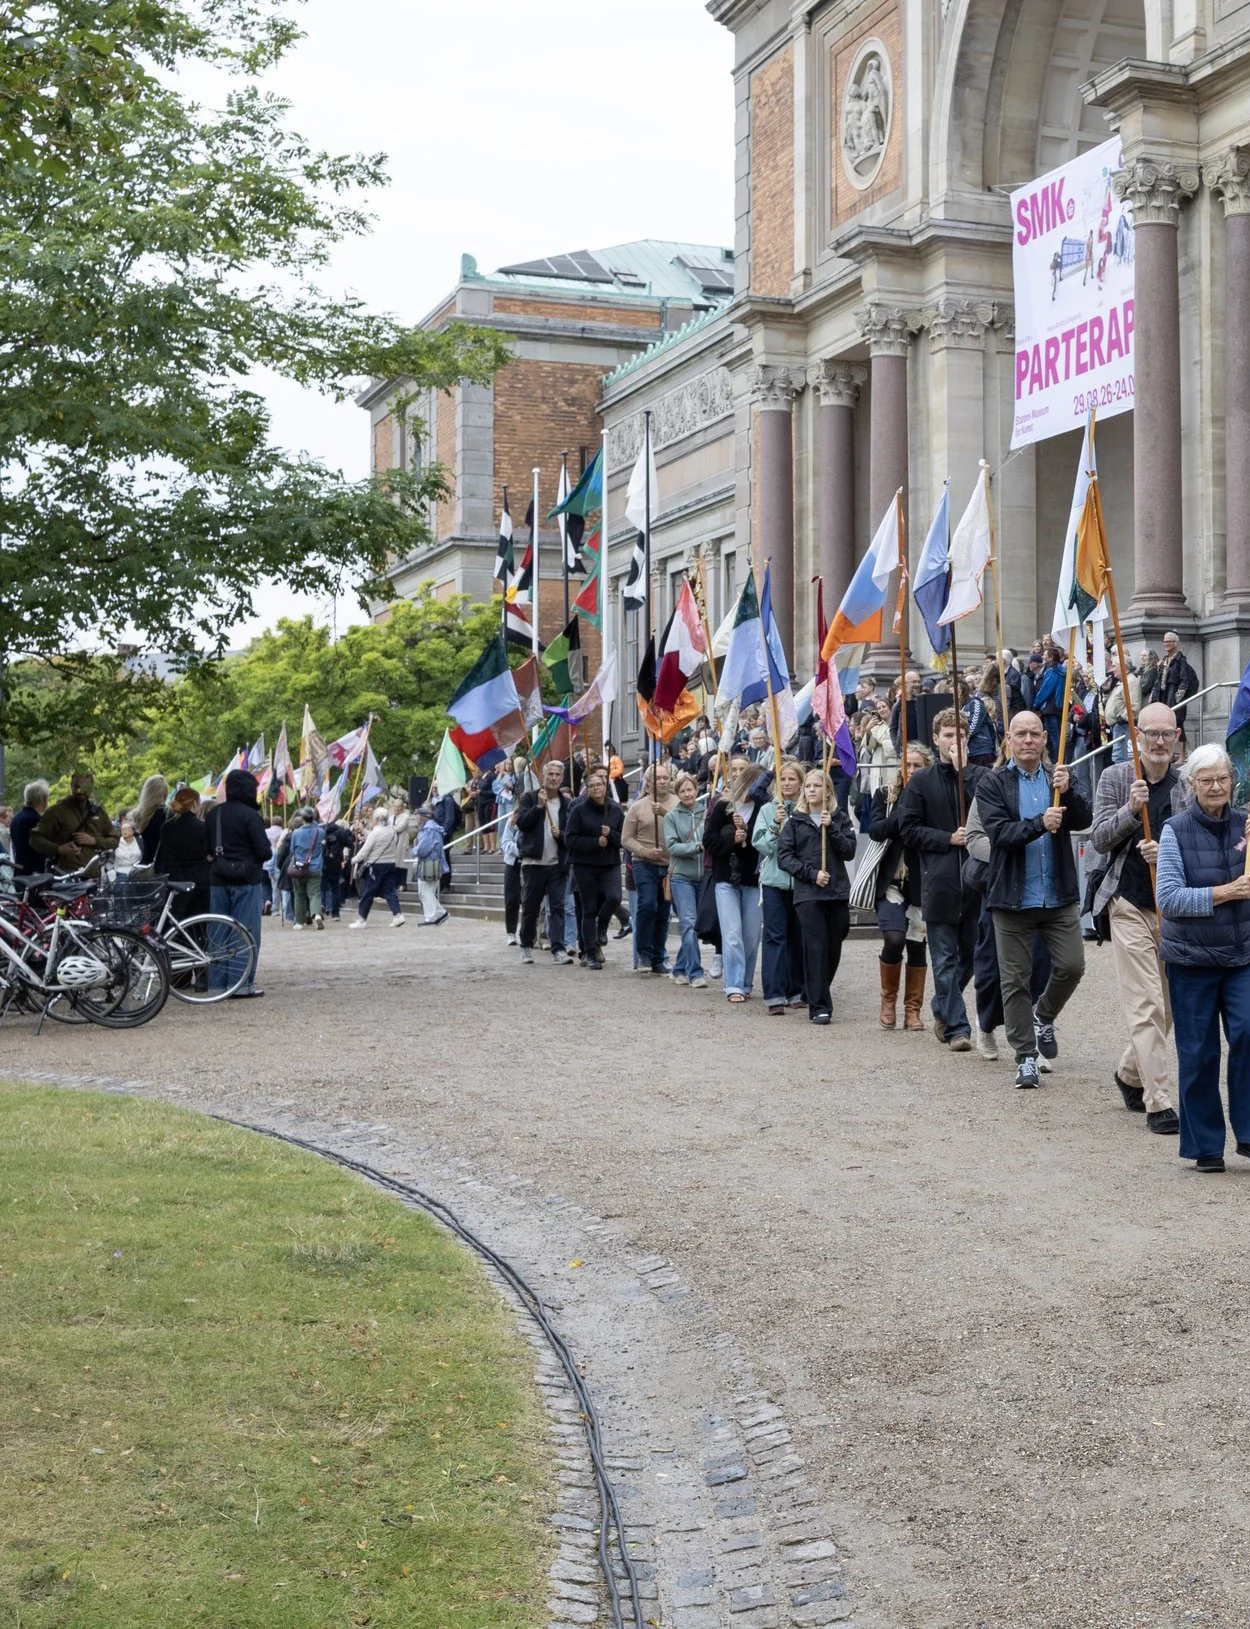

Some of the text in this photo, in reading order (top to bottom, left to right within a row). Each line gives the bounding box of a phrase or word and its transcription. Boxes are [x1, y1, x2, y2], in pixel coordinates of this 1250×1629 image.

[1016, 176, 1066, 246] SMK
[1015, 298, 1135, 400] PARTERAP
[1032, 406, 1049, 419] Museum
